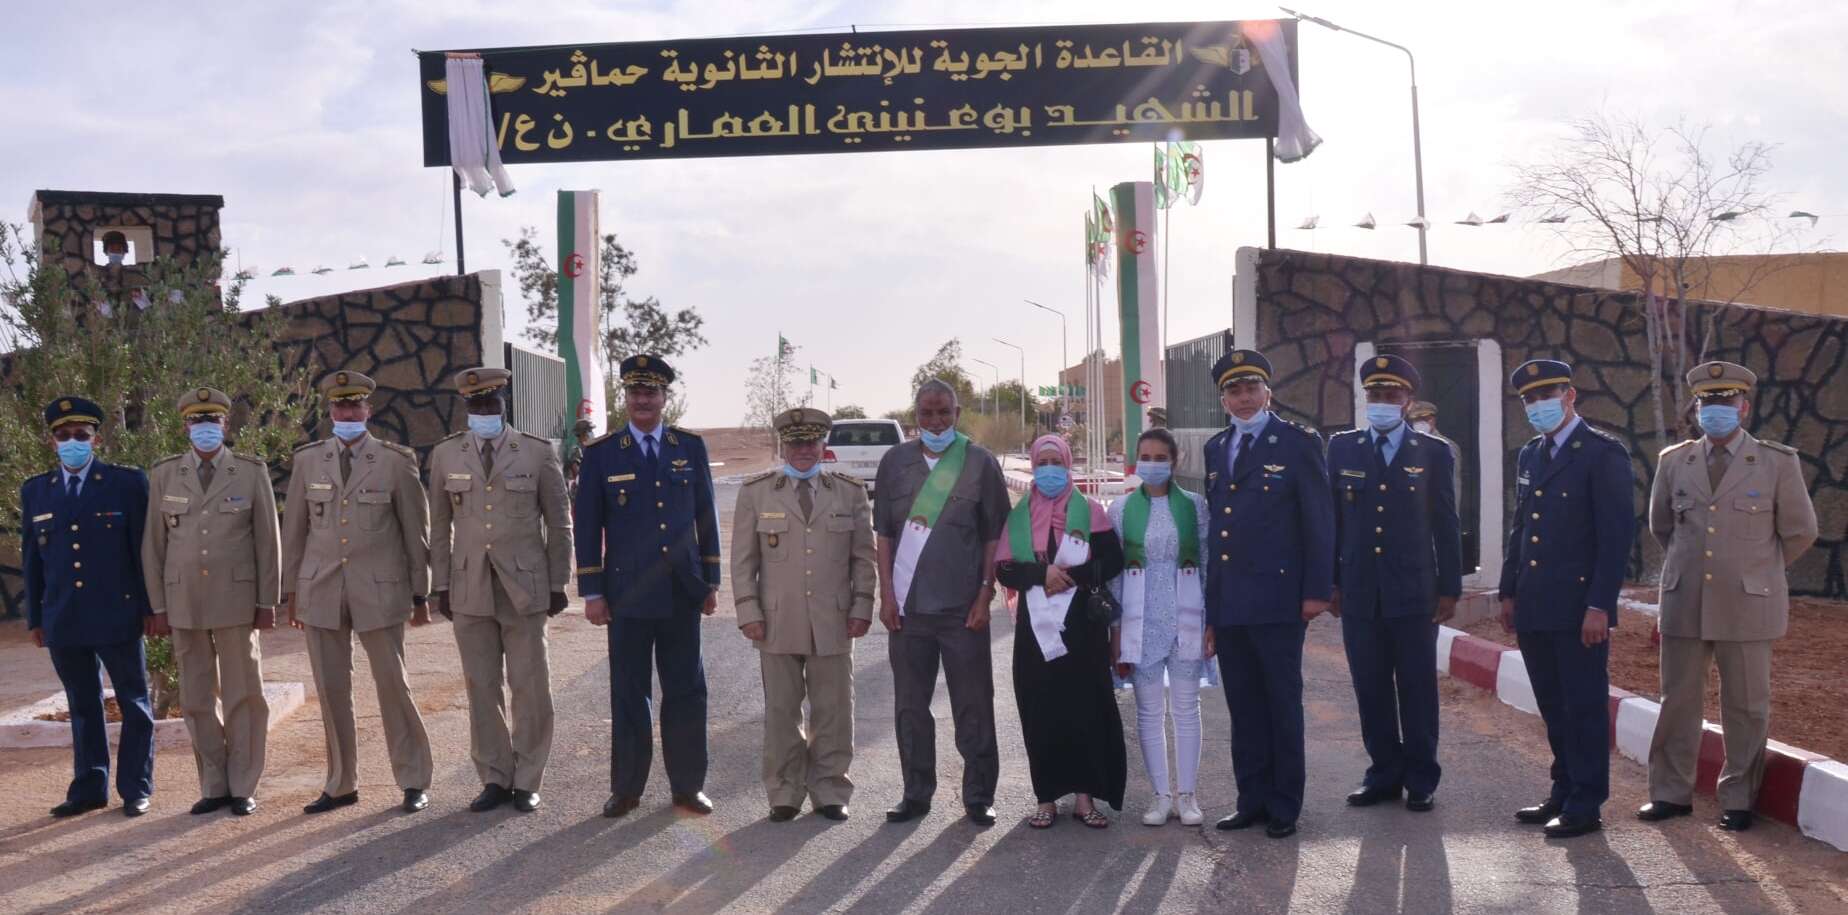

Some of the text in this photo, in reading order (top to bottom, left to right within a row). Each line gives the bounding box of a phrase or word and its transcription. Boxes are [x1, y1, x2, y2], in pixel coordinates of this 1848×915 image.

[661, 44, 798, 92] الثانوية
[804, 42, 923, 86] للإنتشار
[930, 39, 1043, 81] الجوية
[1055, 37, 1183, 69] القاعدة
[606, 103, 819, 152] العماري
[1046, 84, 1259, 137] الشهيد
